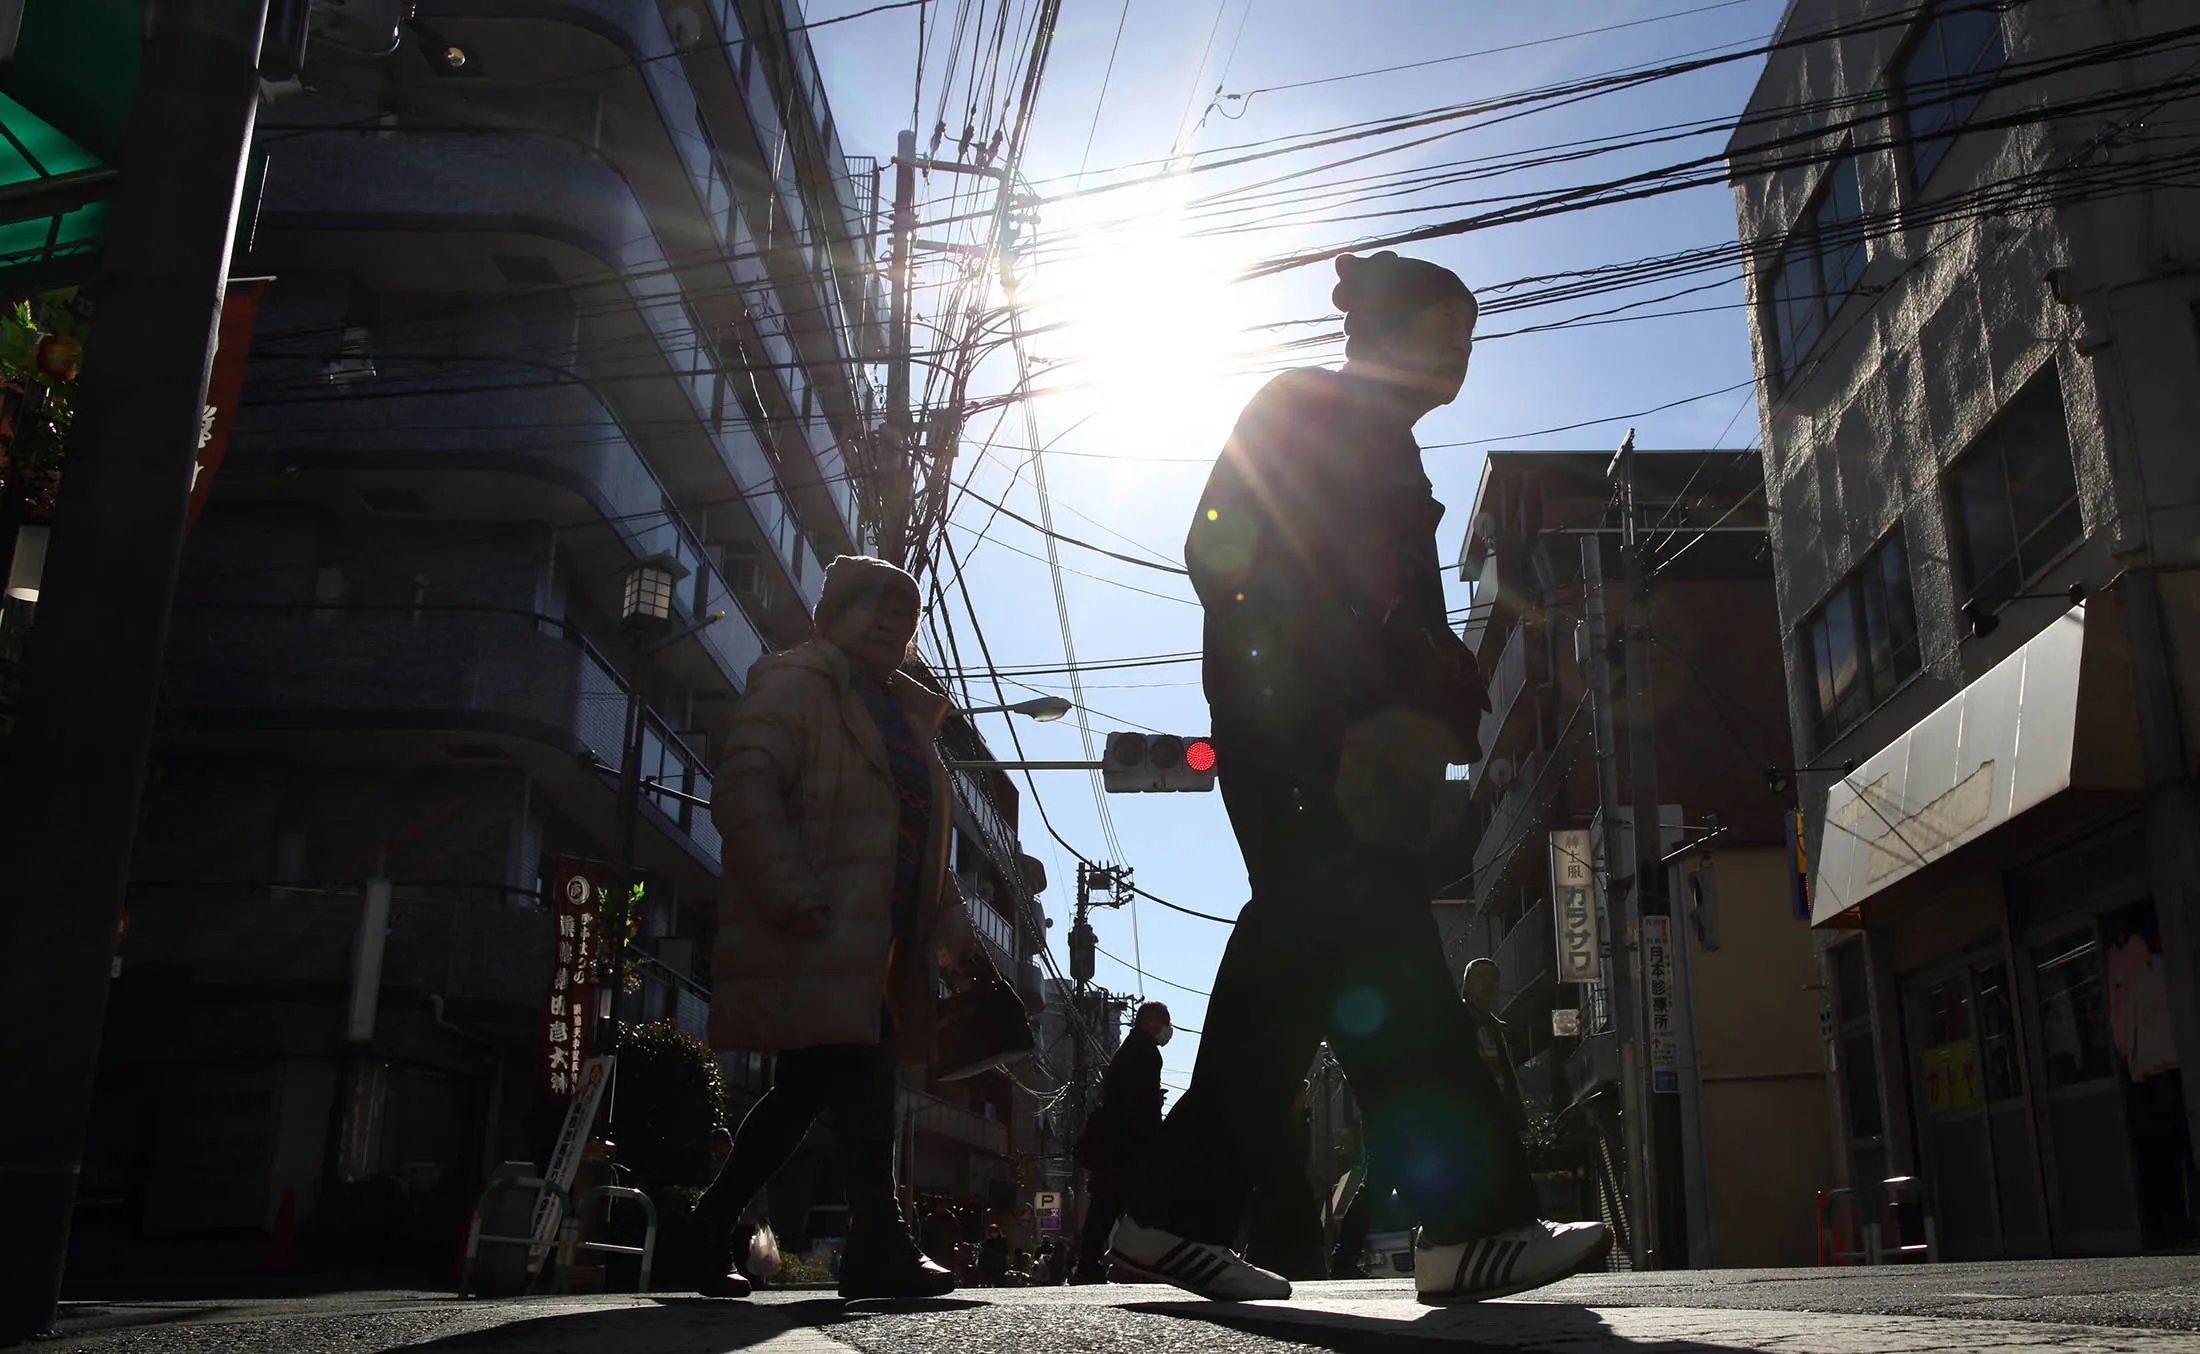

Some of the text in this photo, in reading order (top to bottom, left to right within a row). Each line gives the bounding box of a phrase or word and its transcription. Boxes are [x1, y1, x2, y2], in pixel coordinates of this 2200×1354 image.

[1564, 887, 1592, 972] カラサワ
[1650, 946, 1669, 1030] 月本診療所
[1041, 1194, 1054, 1207] P
